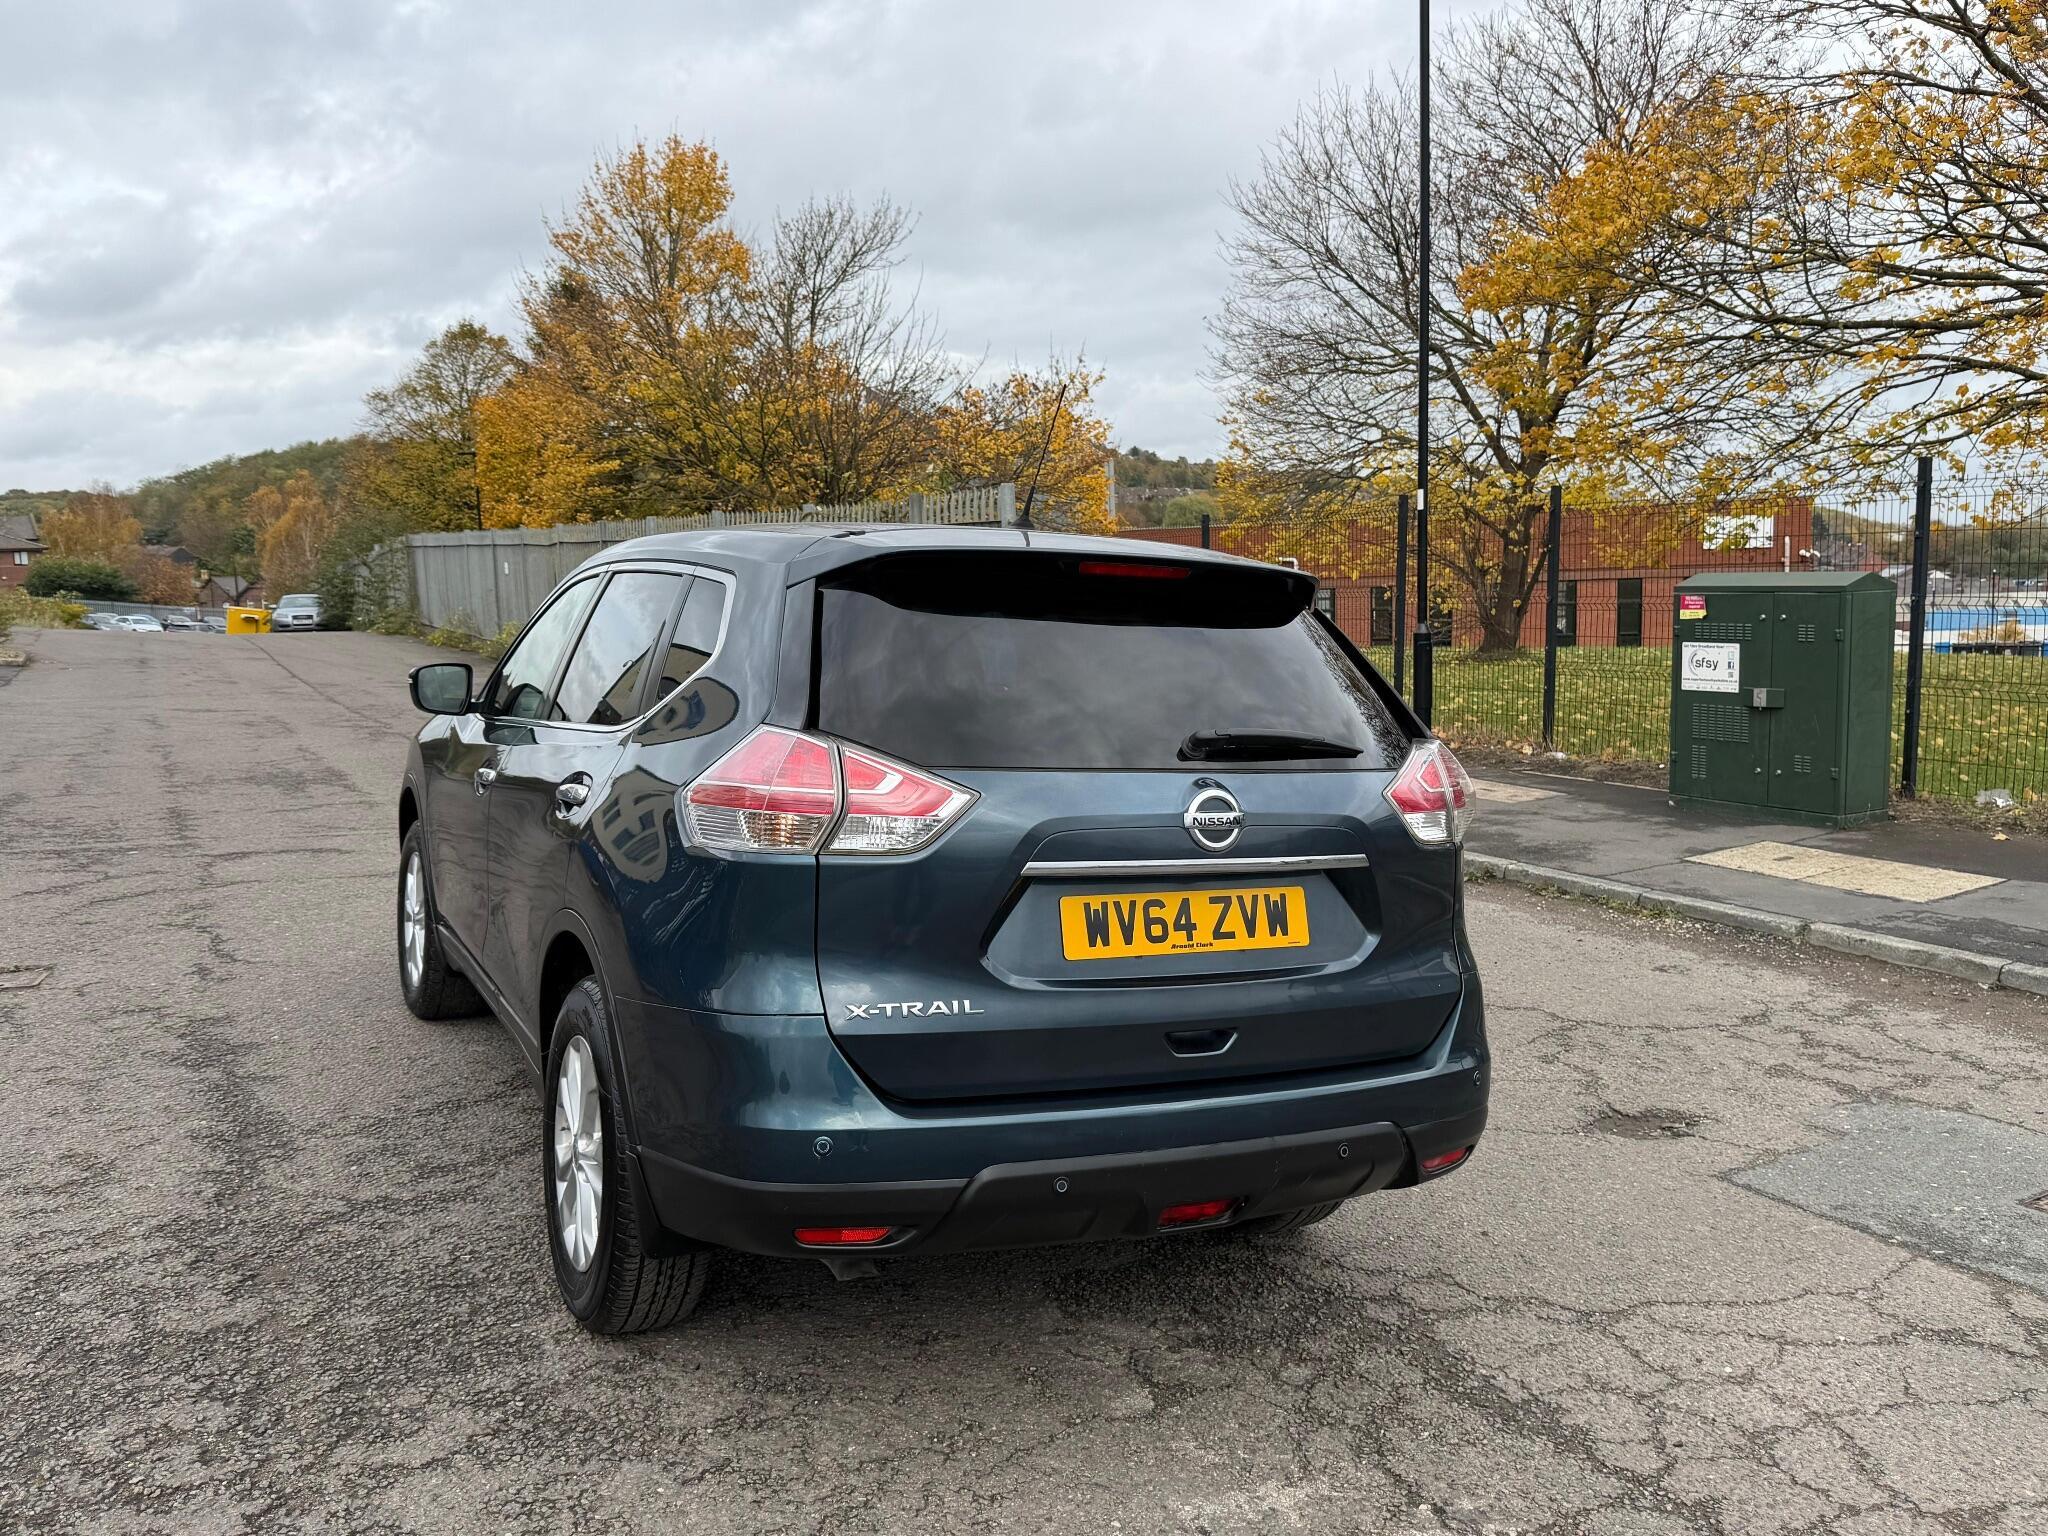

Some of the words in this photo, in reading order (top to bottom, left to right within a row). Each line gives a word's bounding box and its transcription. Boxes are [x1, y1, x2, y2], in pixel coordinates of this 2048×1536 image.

[1694, 657, 1719, 671] sfsy
[1192, 816, 1241, 826] NISSAN
[1083, 898, 1197, 947] WV64
[1208, 893, 1289, 940] ZVW
[845, 999, 985, 1020] X-TRAIL
